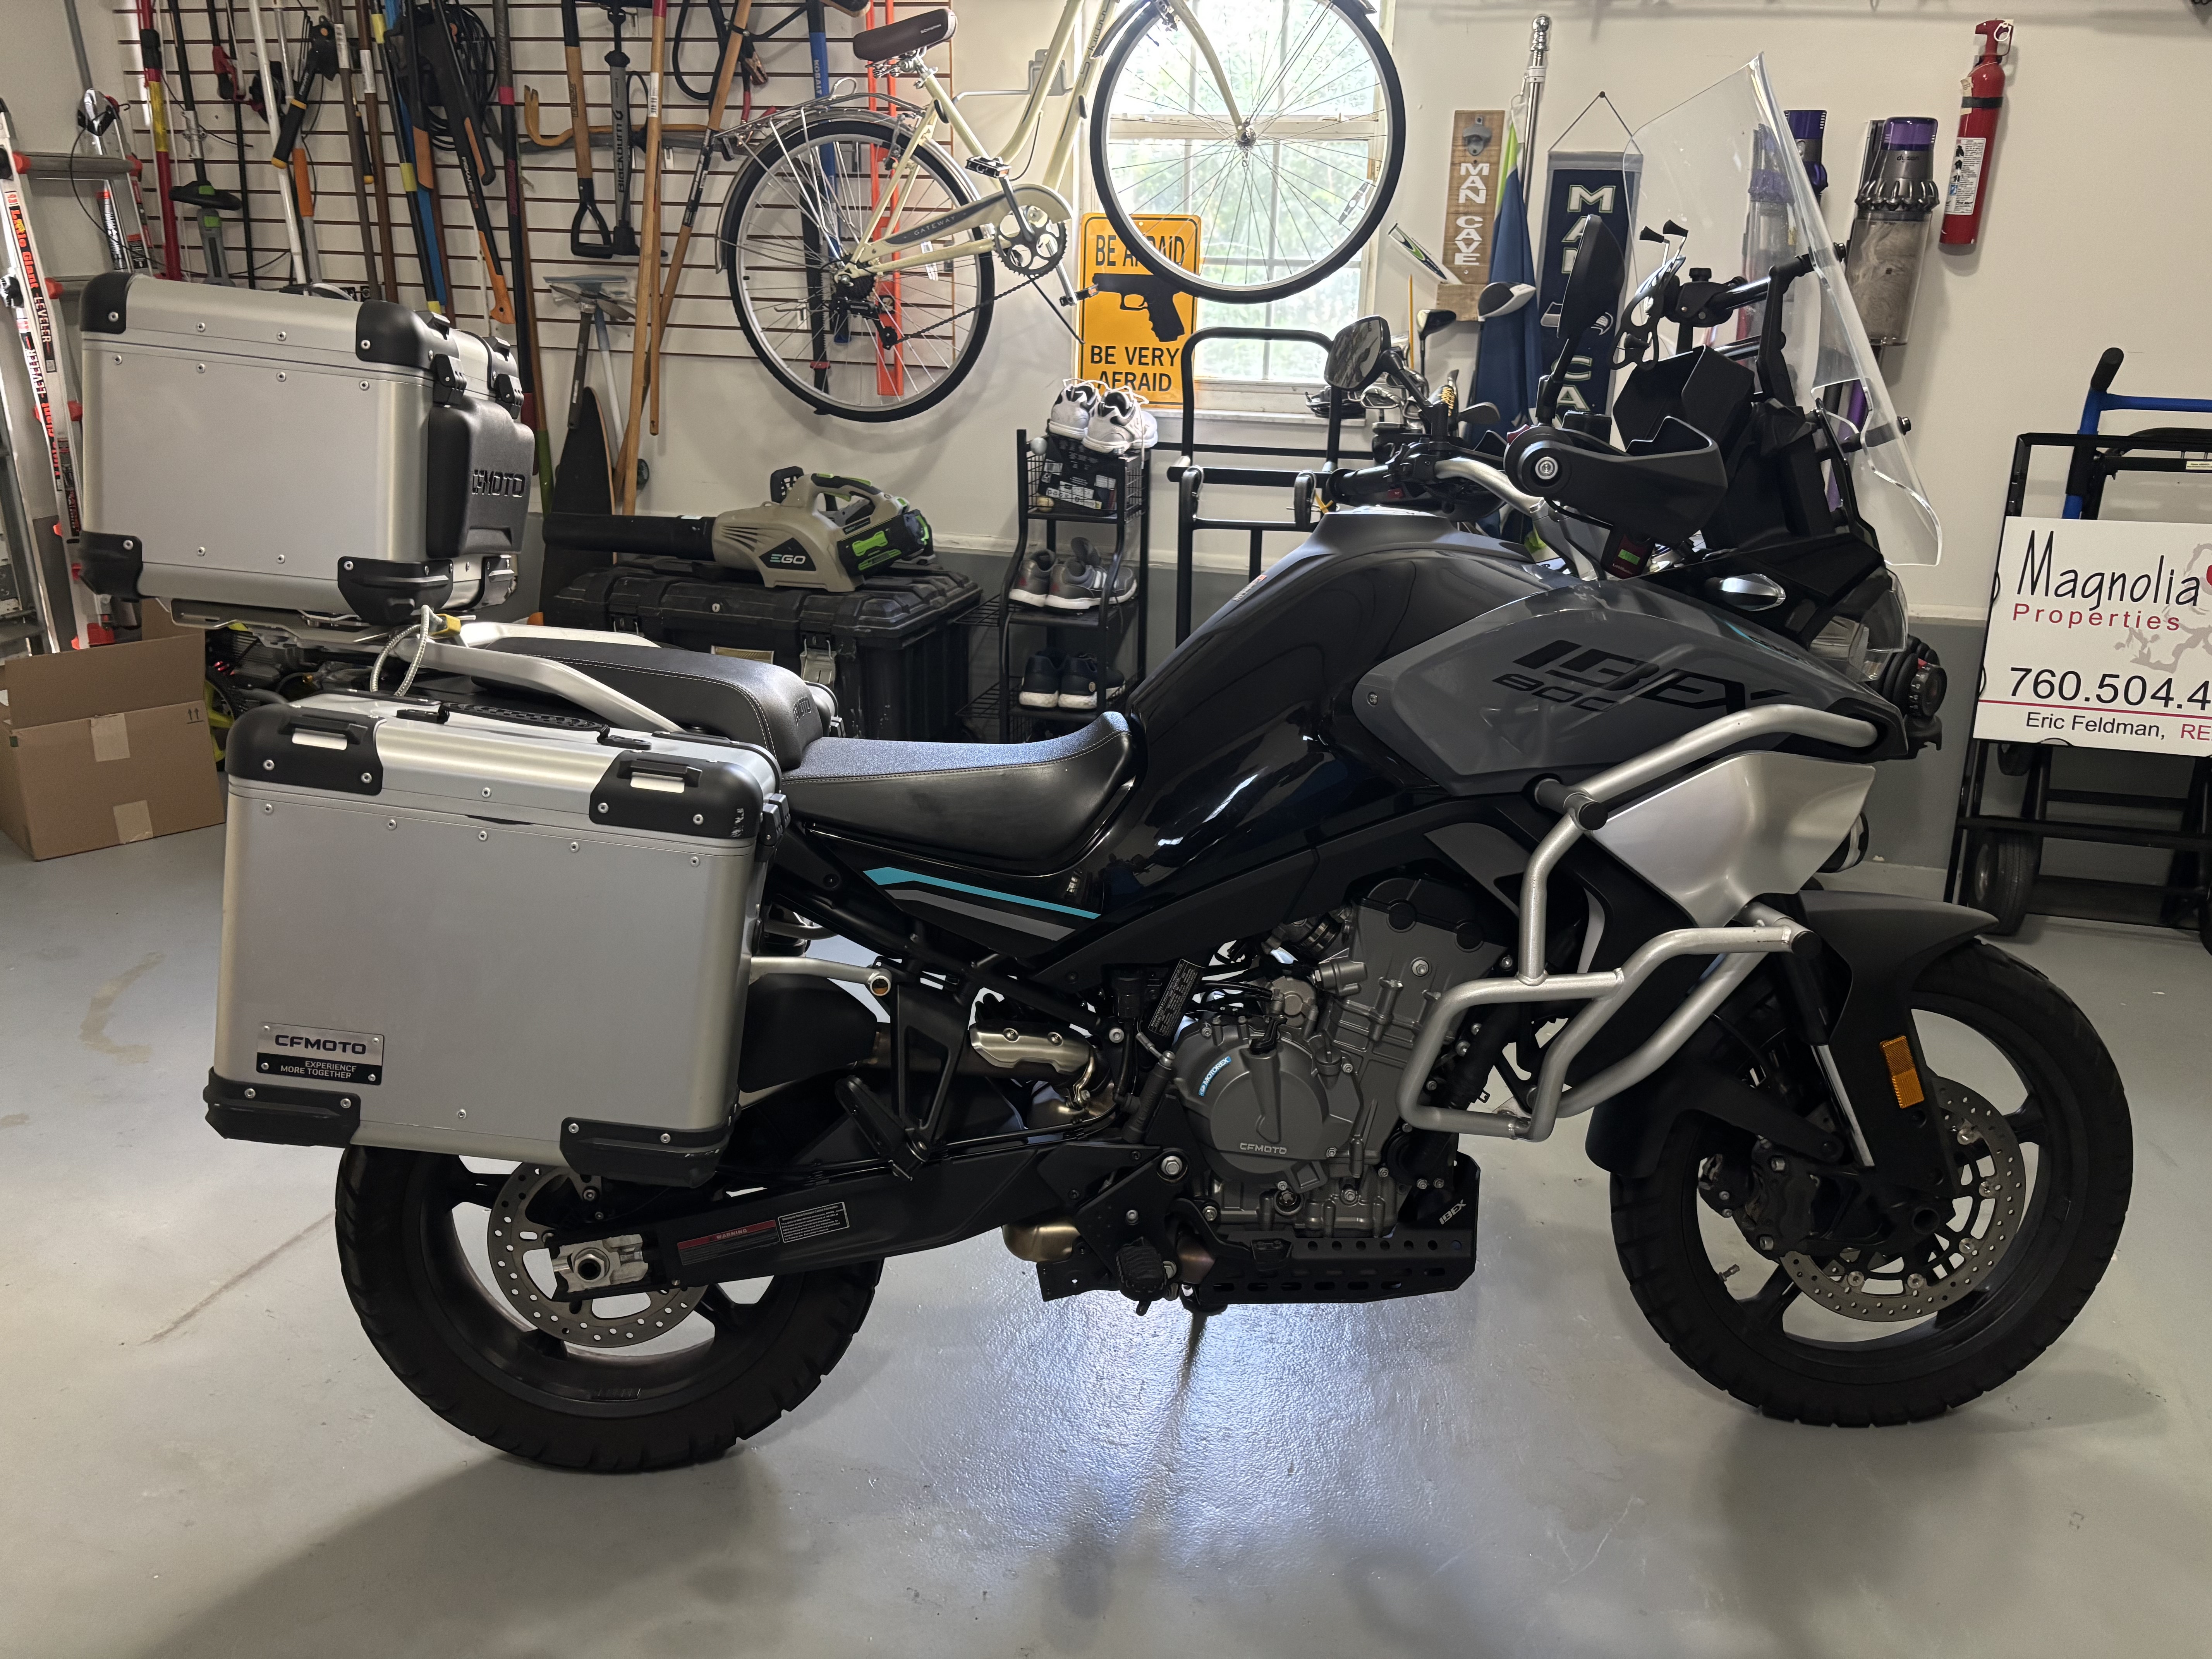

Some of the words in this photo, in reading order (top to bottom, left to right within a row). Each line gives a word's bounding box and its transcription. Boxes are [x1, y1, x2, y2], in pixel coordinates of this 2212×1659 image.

[814, 60, 822, 94] KOBALT
[616, 124, 625, 193] Blackburn
[462, 157, 475, 192] FISKARS
[1458, 163, 1490, 204] MAN
[914, 216, 955, 235] GATEWAY
[1096, 235, 1116, 266] BE
[1123, 235, 1185, 267] AAID
[1454, 216, 1483, 266] CAVE
[22, 251, 39, 289] Giant
[33, 297, 51, 343] LEVELER
[1091, 345, 1116, 365] BE
[1125, 347, 1180, 367] VERY
[26, 349, 46, 395] LEVELER
[1097, 371, 1172, 392] AFRAID
[770, 554, 806, 564] EGO
[2017, 530, 2200, 611] Magnolia
[2013, 603, 2180, 631] Properties
[1512, 640, 1791, 716] IBEX
[2026, 711, 2065, 730] Eric
[2071, 715, 2165, 740] Feldman,
[2180, 723, 2212, 741] RE
[275, 1034, 366, 1055] CFMOTO
[281, 1065, 305, 1074] MORE
[308, 1068, 351, 1079] TOGETHER
[305, 1061, 357, 1072] EXPERIENCE
[1203, 1056, 1229, 1085] MOTOREX
[1240, 1142, 1287, 1154] CFMOTO
[1439, 1199, 1467, 1225] IBEX
[716, 1228, 747, 1240] WARNING
